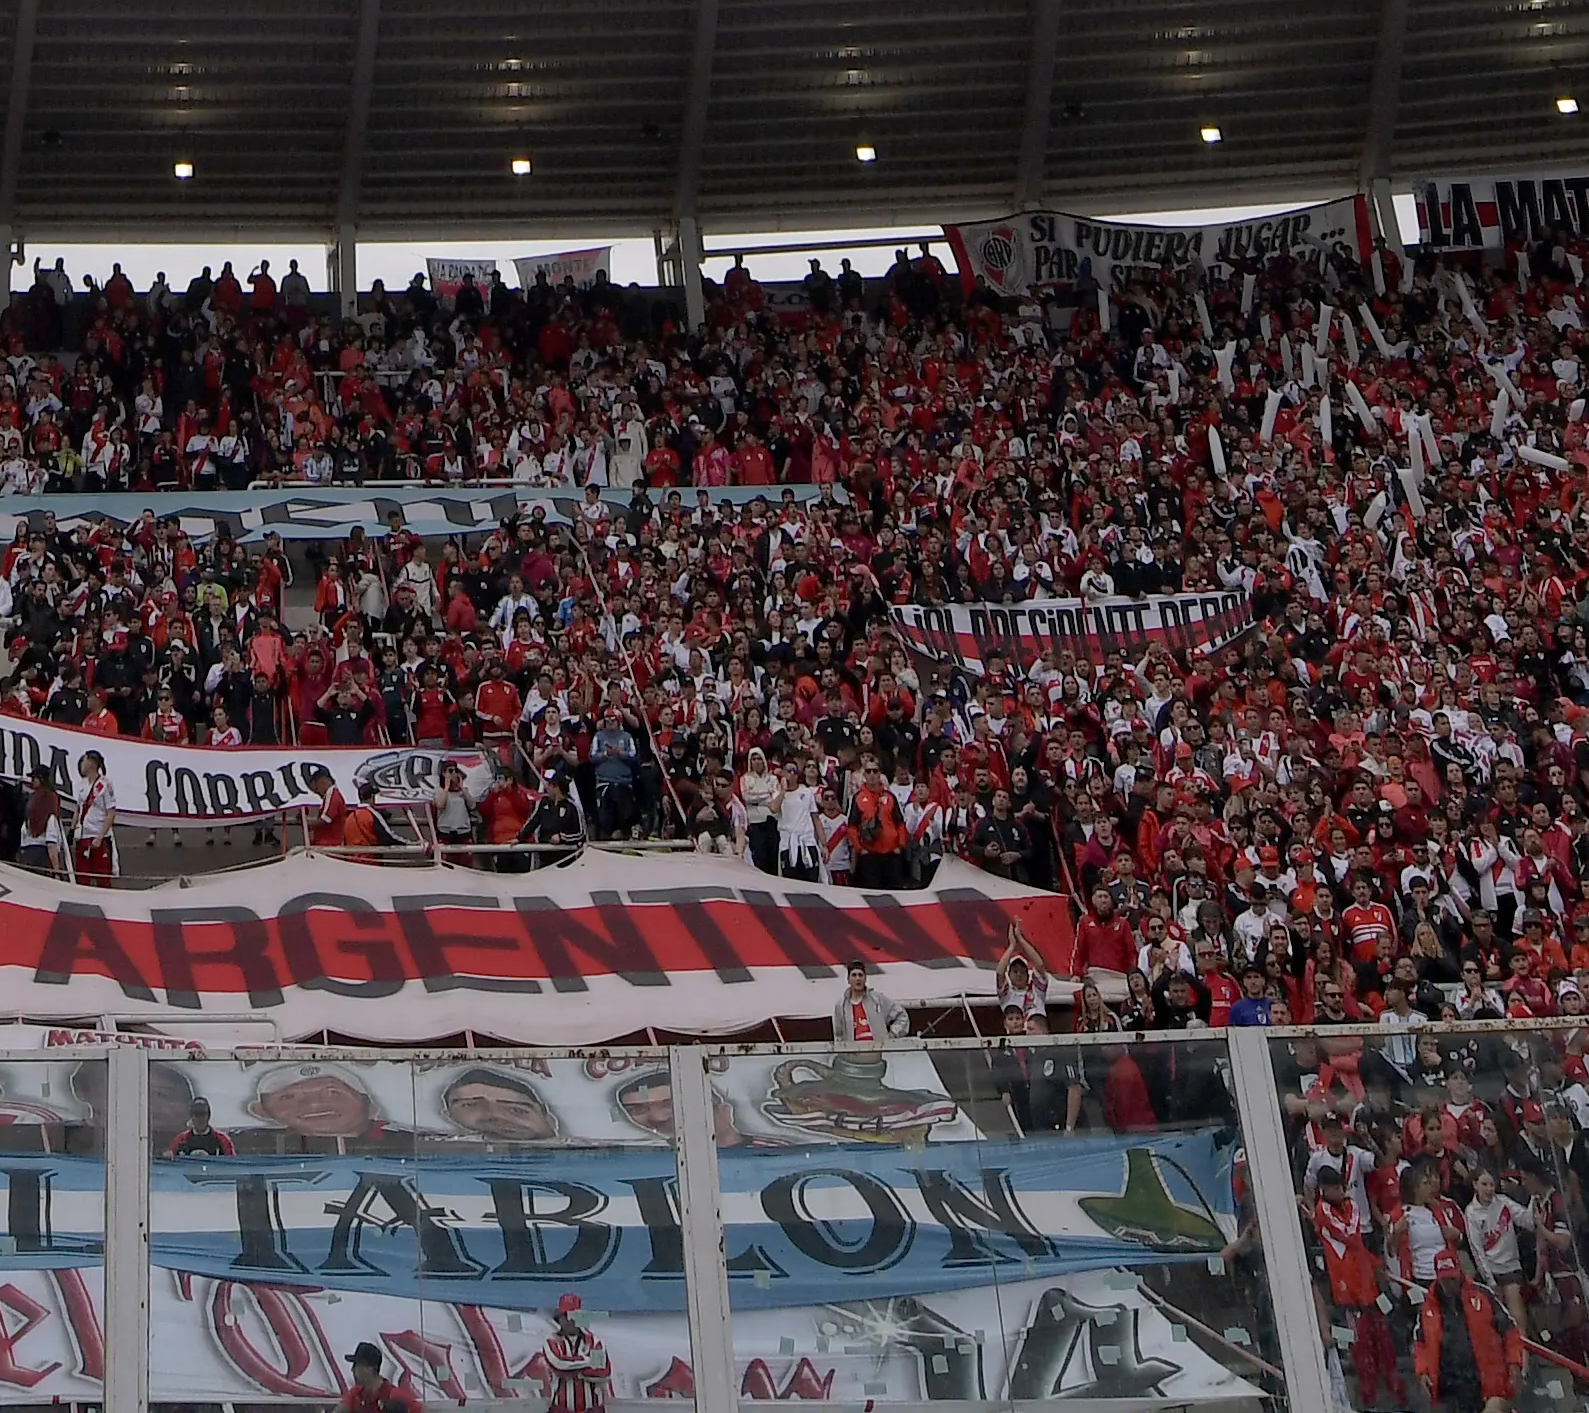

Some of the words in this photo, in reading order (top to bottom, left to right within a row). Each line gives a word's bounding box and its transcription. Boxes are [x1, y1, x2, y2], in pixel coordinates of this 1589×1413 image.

[1030, 215, 1056, 244] SI
[1076, 223, 1202, 262] PUDIERA
[1425, 182, 1484, 247] LA
[33, 885, 1026, 1010] ARGENTINA
[185, 1167, 1059, 1282] TABLON
